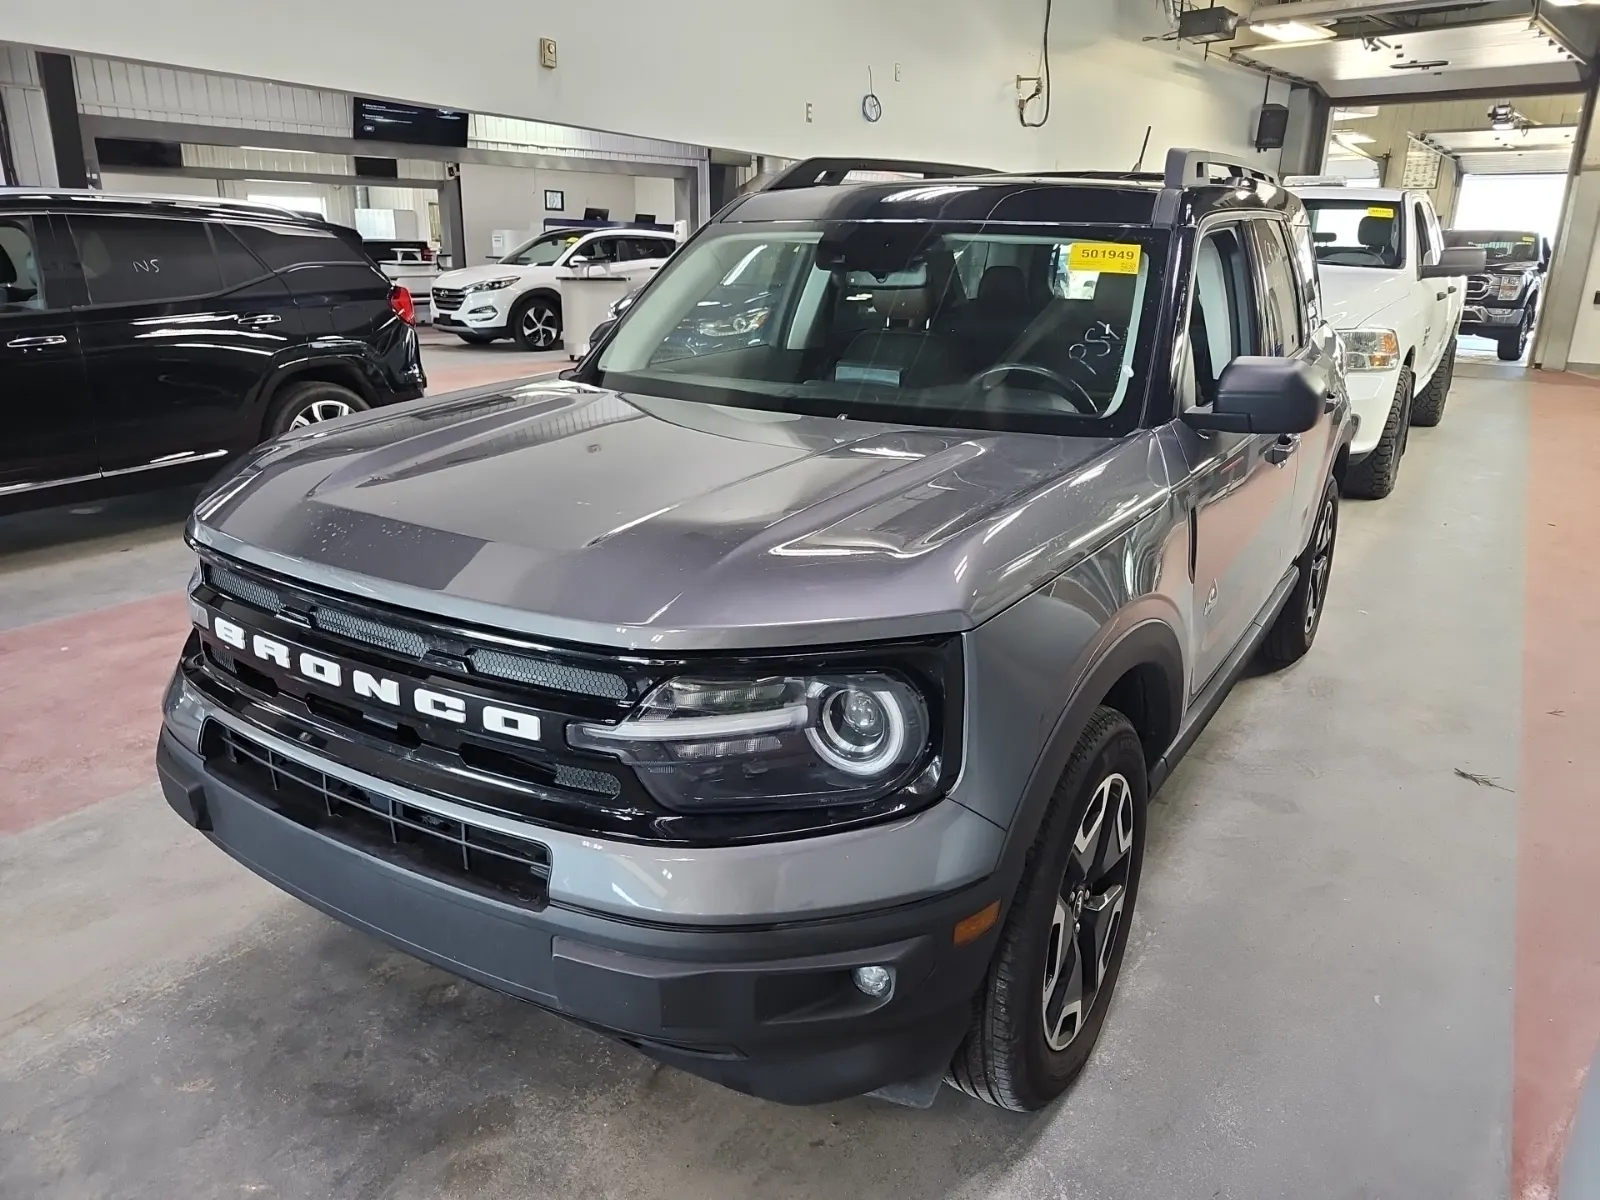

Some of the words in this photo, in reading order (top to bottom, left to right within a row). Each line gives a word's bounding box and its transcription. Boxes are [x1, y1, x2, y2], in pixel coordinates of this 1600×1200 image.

[1081, 249, 1135, 260] 501949
[132, 258, 160, 273] NS
[214, 616, 542, 742] BRONCO
